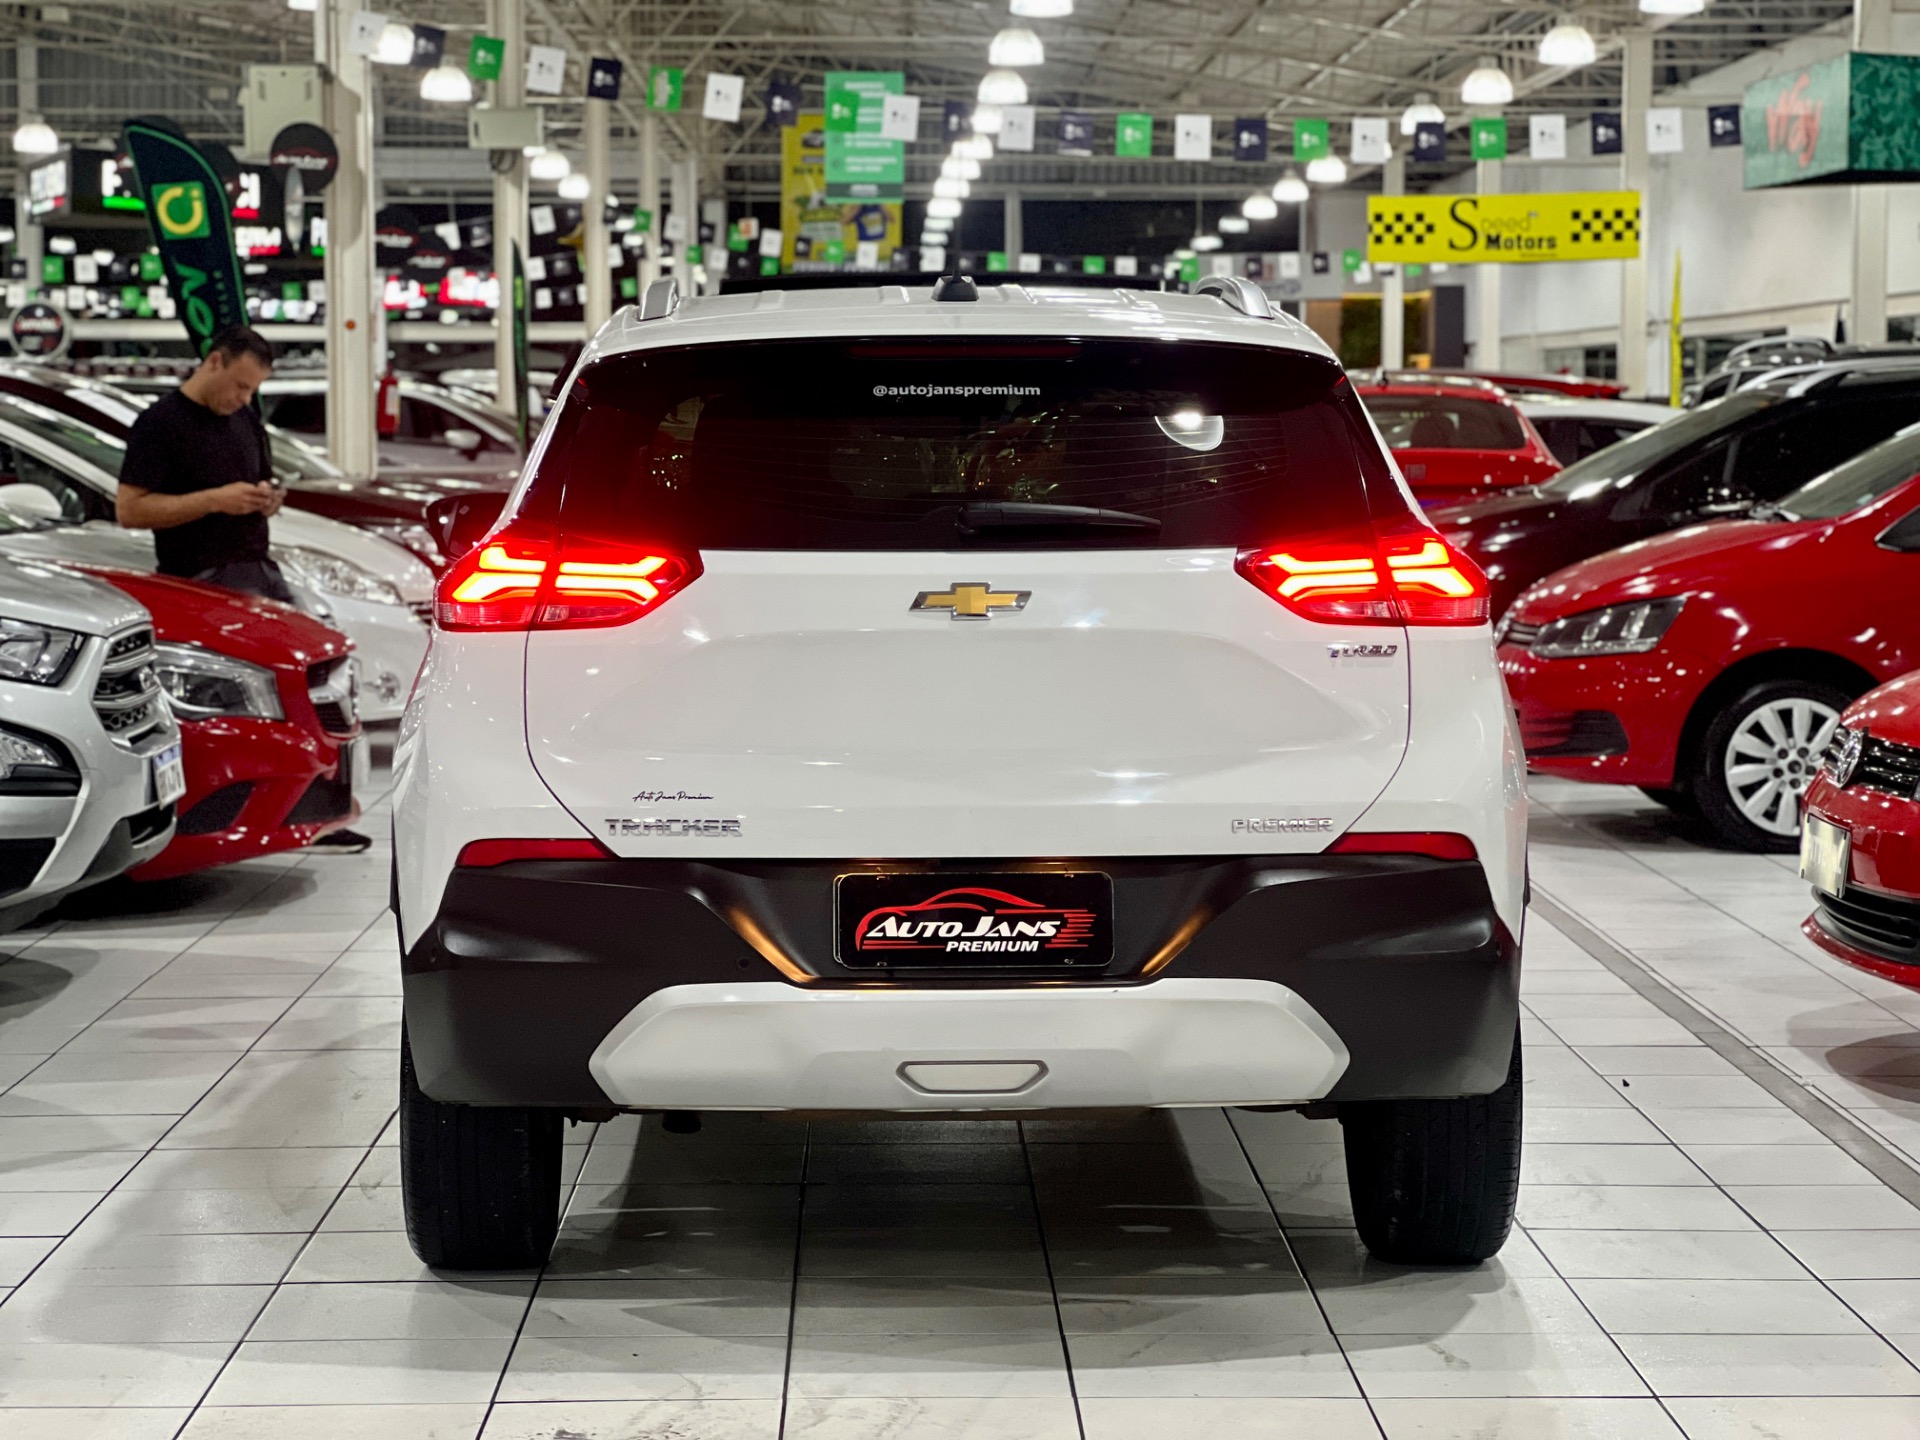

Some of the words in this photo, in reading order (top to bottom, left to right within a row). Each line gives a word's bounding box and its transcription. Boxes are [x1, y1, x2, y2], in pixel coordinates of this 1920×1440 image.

[1486, 233, 1557, 251] Motors
[873, 384, 1041, 397] @autojanspremium
[605, 819, 742, 837] TRACKER
[1231, 818, 1334, 834] PREMIER
[946, 941, 1038, 952] PREMIUM
